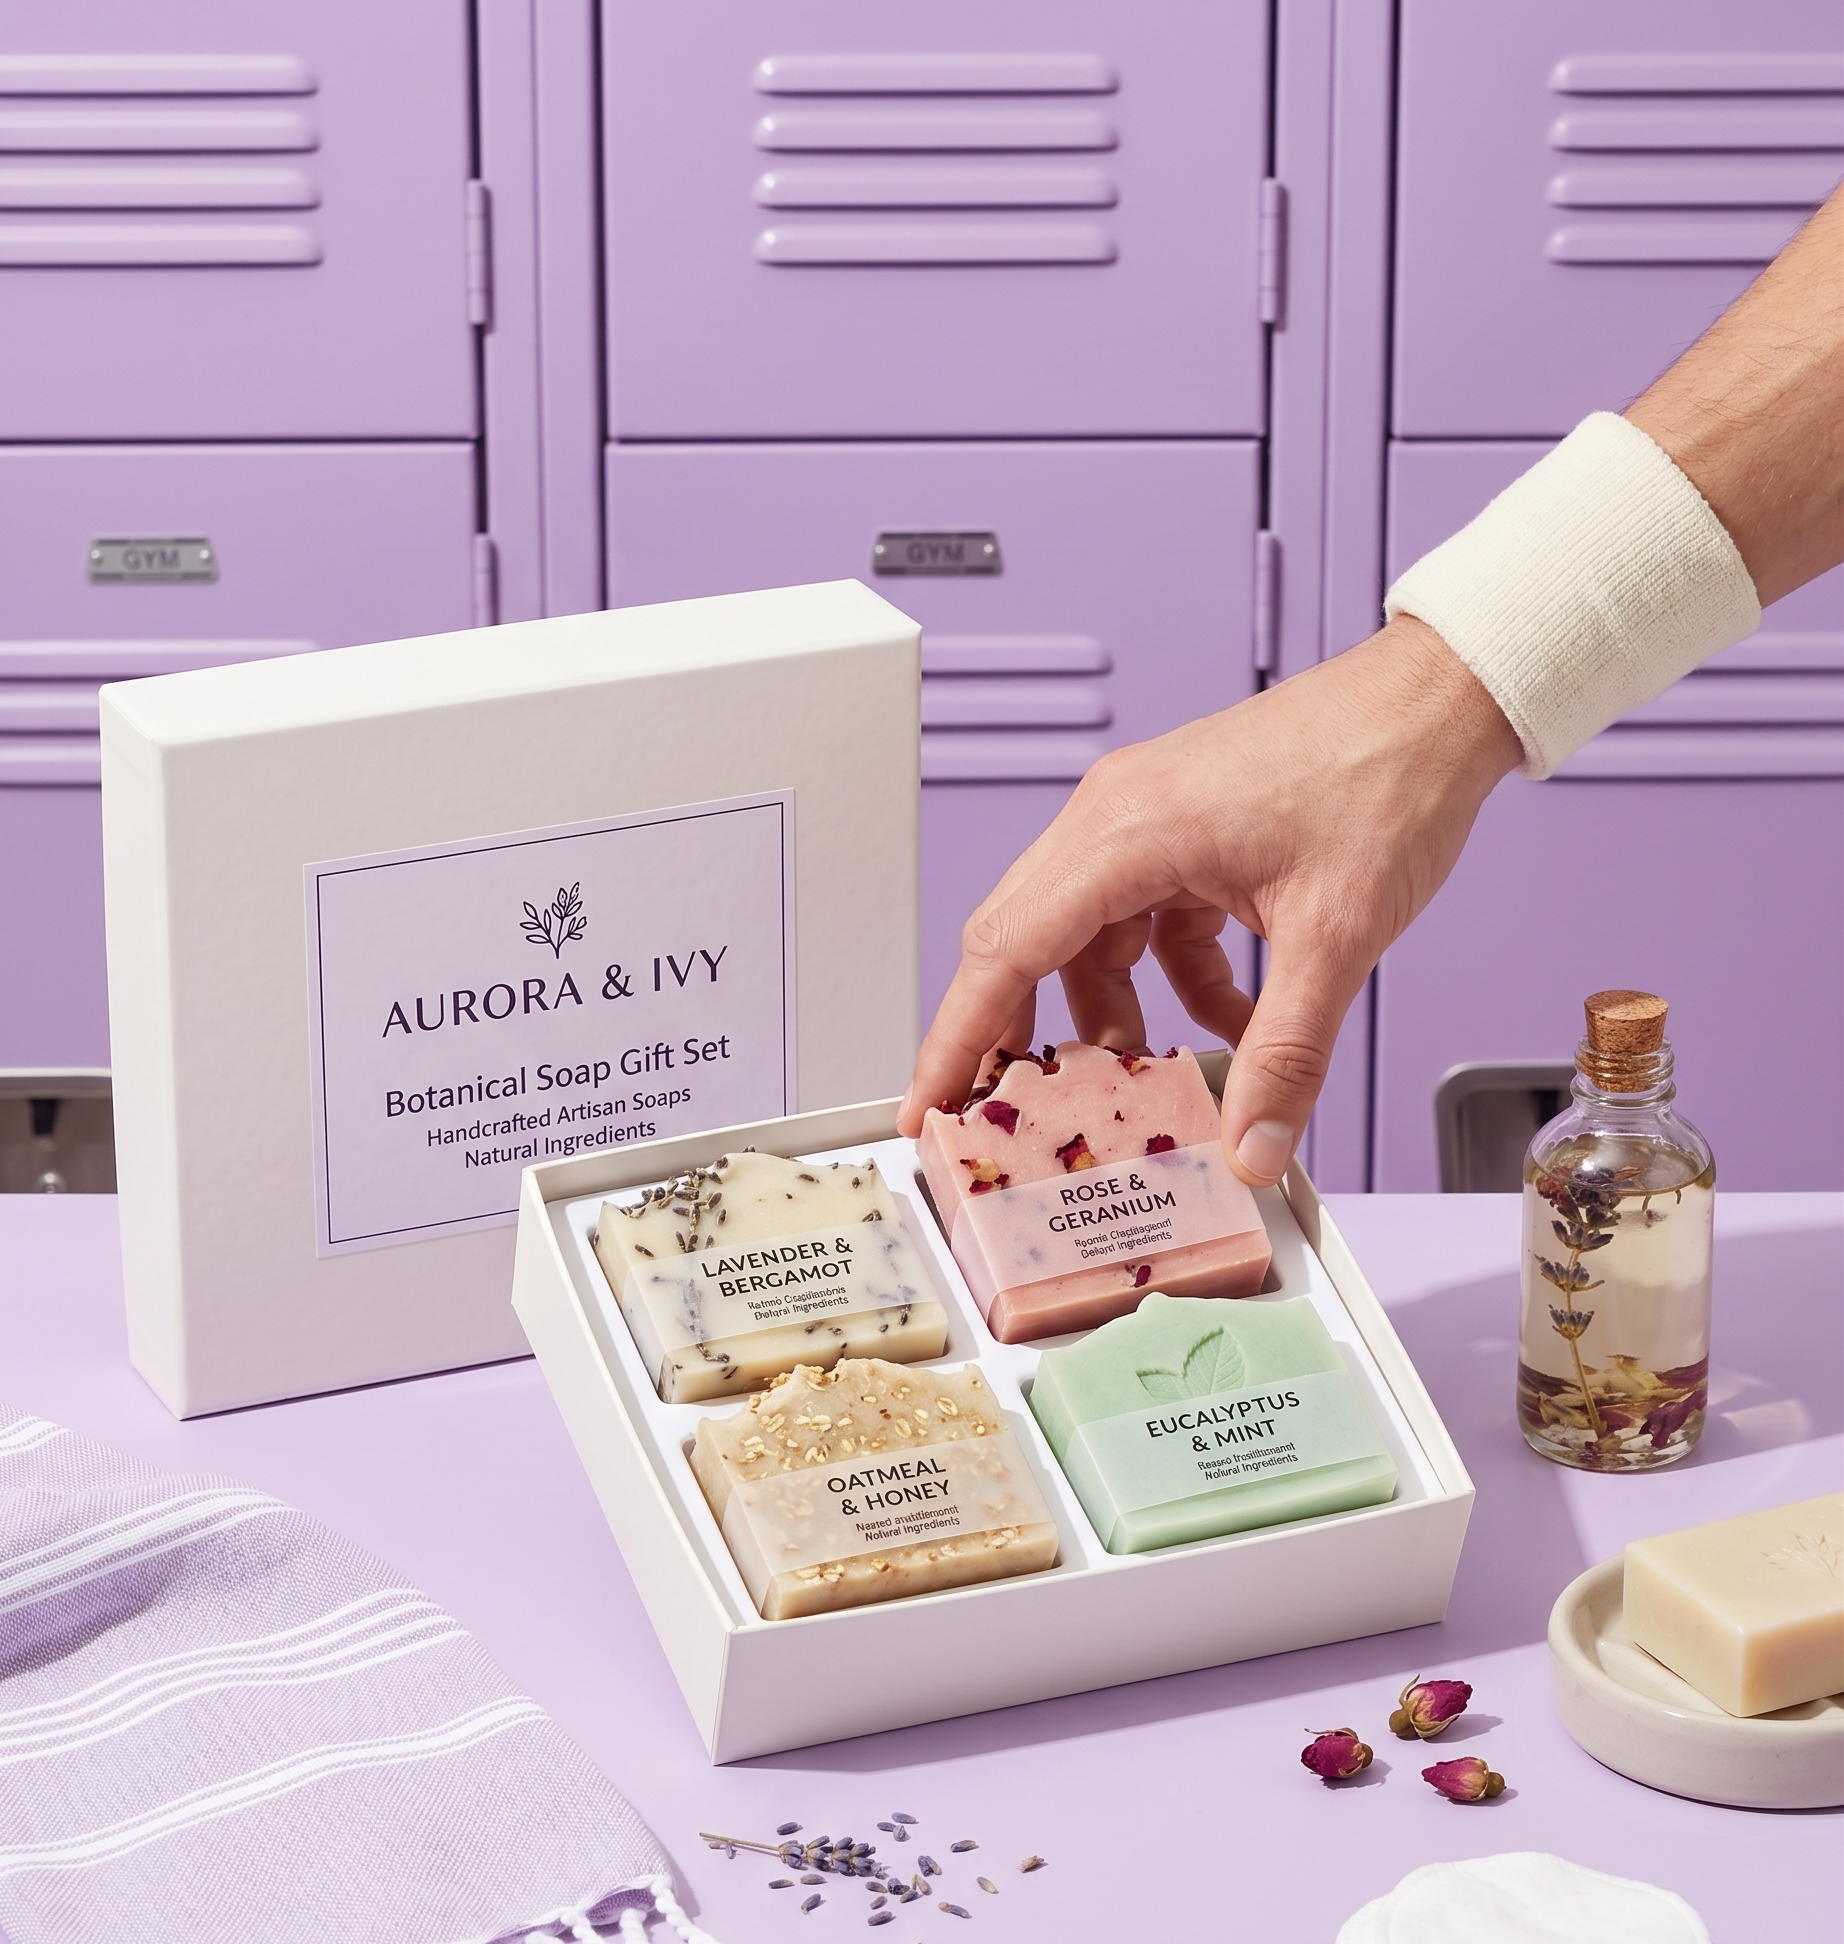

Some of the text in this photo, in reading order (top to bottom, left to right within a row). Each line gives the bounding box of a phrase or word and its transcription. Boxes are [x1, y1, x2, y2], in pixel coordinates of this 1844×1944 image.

[121, 548, 181, 571] GYM
[906, 542, 965, 564] GYM
[382, 945, 728, 1038] AURORA & IVY
[386, 1035, 731, 1118] Botanical Soap Gift Set
[427, 1086, 692, 1147] Handcrafted Artisan Soaps
[465, 1120, 656, 1168] Natural Ingredients
[1059, 1173, 1147, 1206] ROSE &
[1048, 1191, 1177, 1232] GERANIUM
[701, 1237, 854, 1278] LAVENDER &
[719, 1259, 852, 1297] BERGAMOT
[1146, 1391, 1300, 1438] EUCALYPTUS
[1191, 1419, 1275, 1452] & MINT
[827, 1458, 946, 1493] OATMEAL
[841, 1479, 949, 1516] & HONEY
